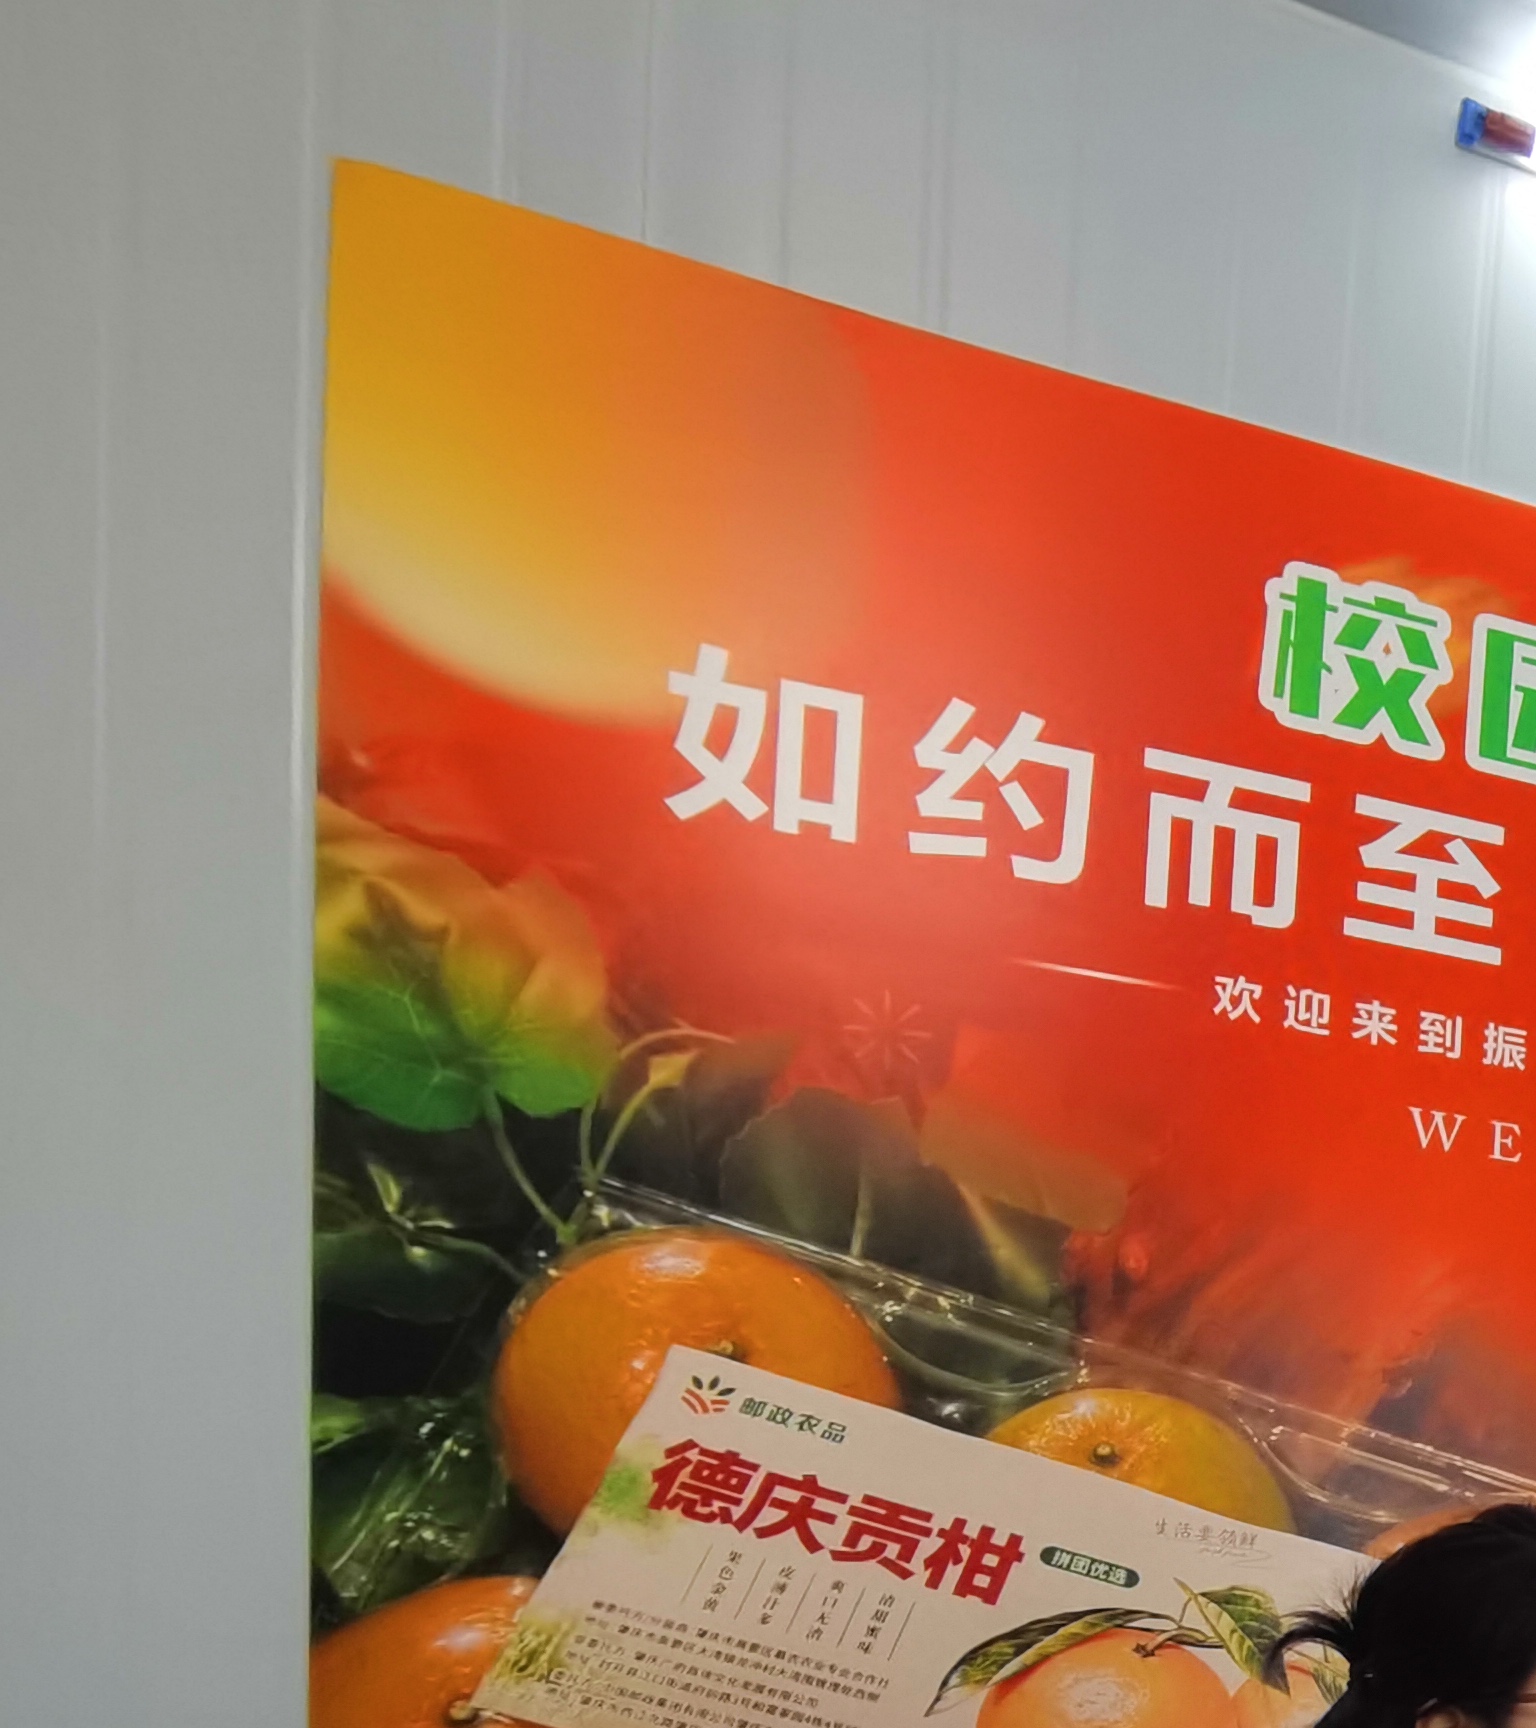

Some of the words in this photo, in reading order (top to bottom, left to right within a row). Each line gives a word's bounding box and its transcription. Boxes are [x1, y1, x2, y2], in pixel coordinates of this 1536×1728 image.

[664, 643, 1506, 966] 如约而至
[738, 1396, 848, 1445] 邮政农品
[647, 1438, 1025, 1606] 德庆贡柑
[1051, 1549, 1128, 1586] 拼团优选
